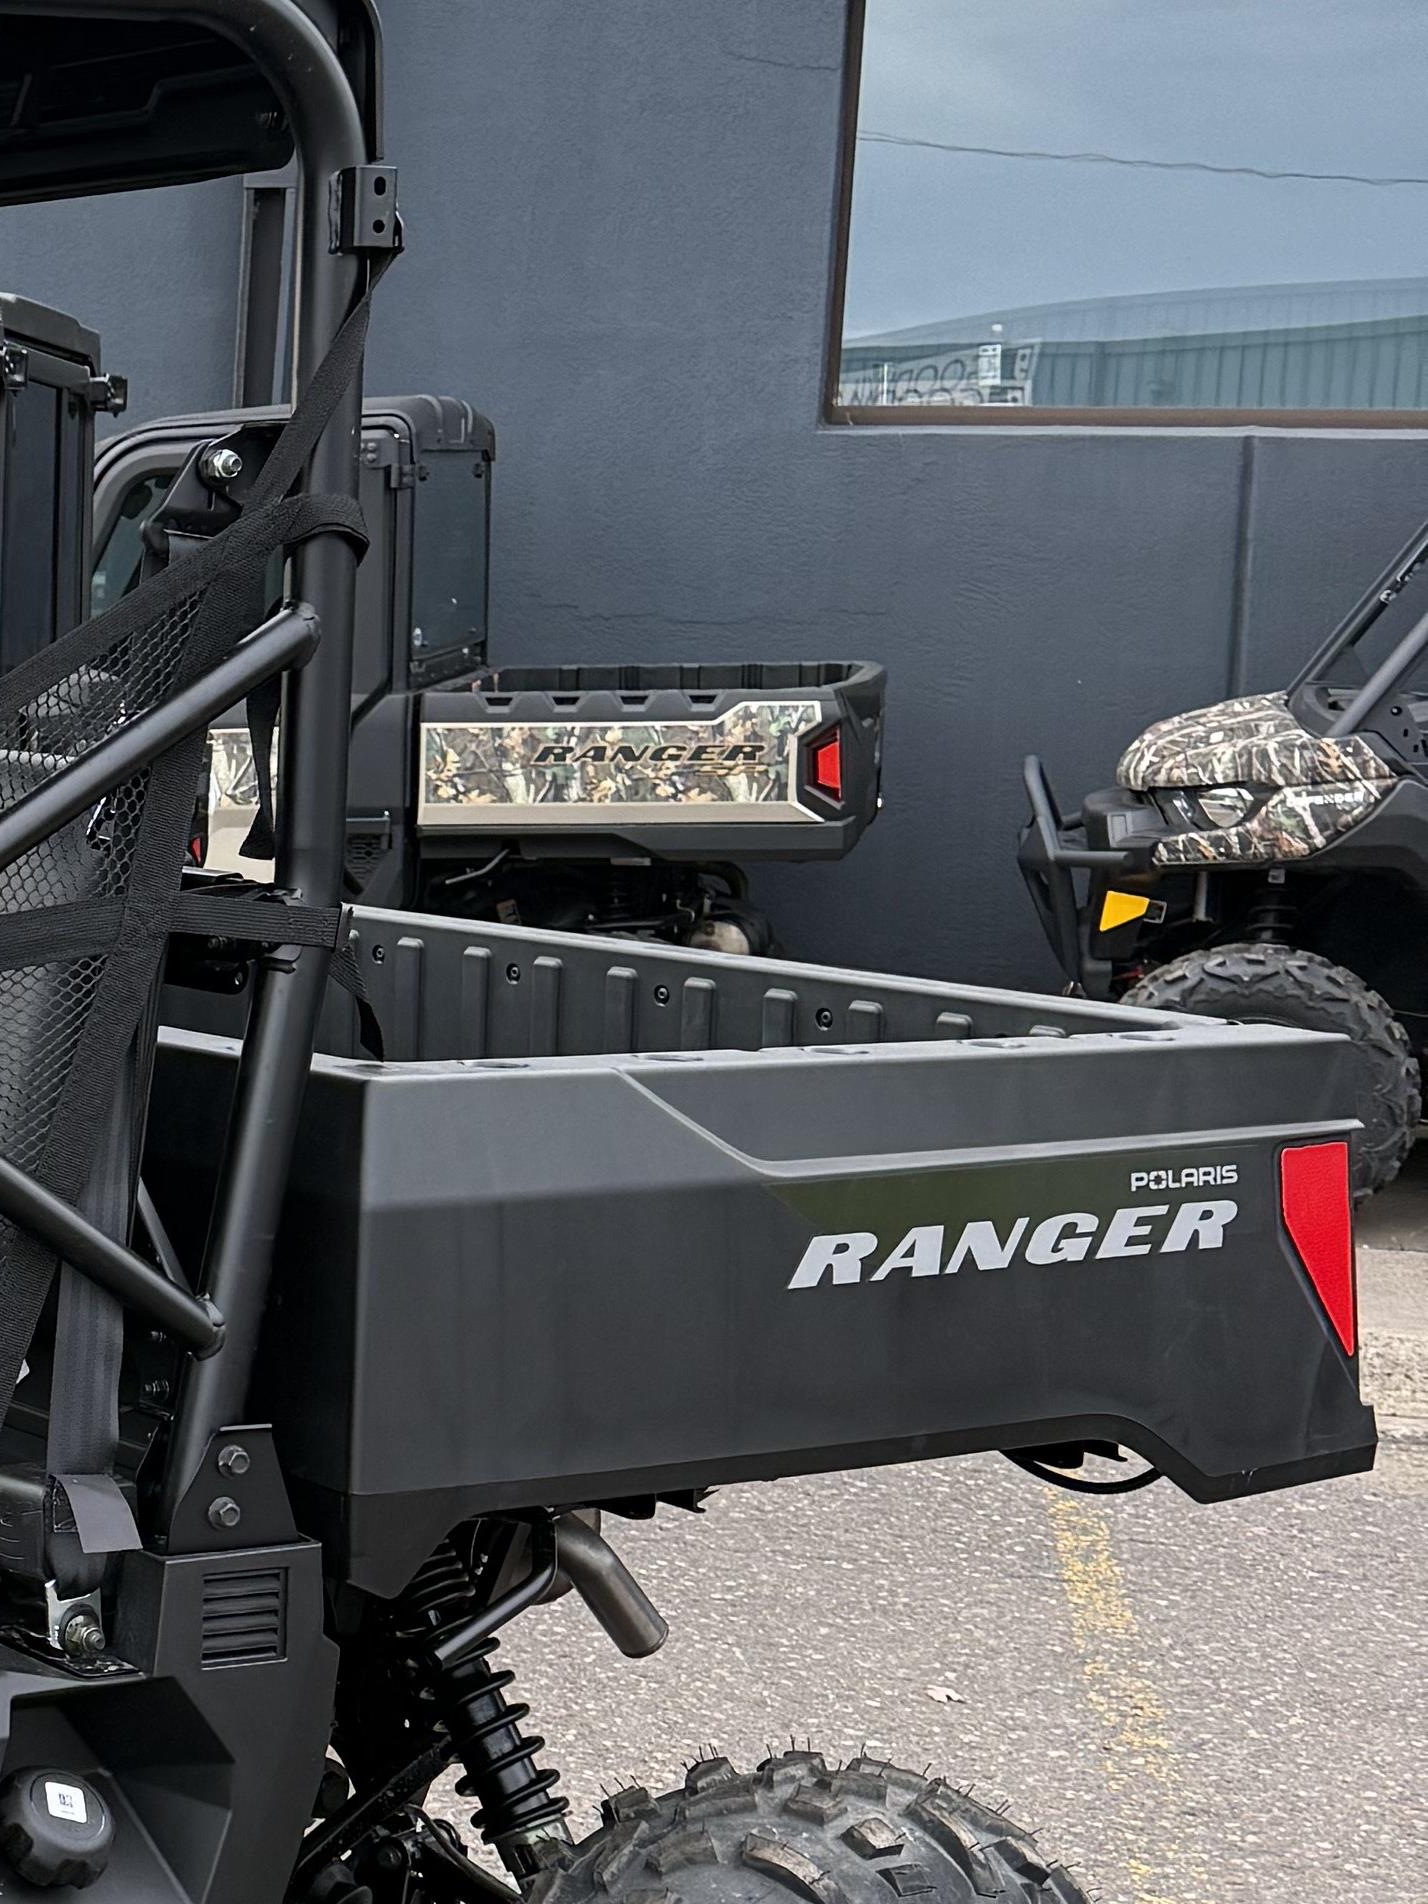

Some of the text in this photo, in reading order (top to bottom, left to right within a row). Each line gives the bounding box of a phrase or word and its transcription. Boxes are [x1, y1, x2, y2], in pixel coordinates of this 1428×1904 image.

[530, 744, 767, 765] RANGER
[1130, 1164, 1239, 1192] POLARIS
[787, 1199, 1239, 1290] RANGER
